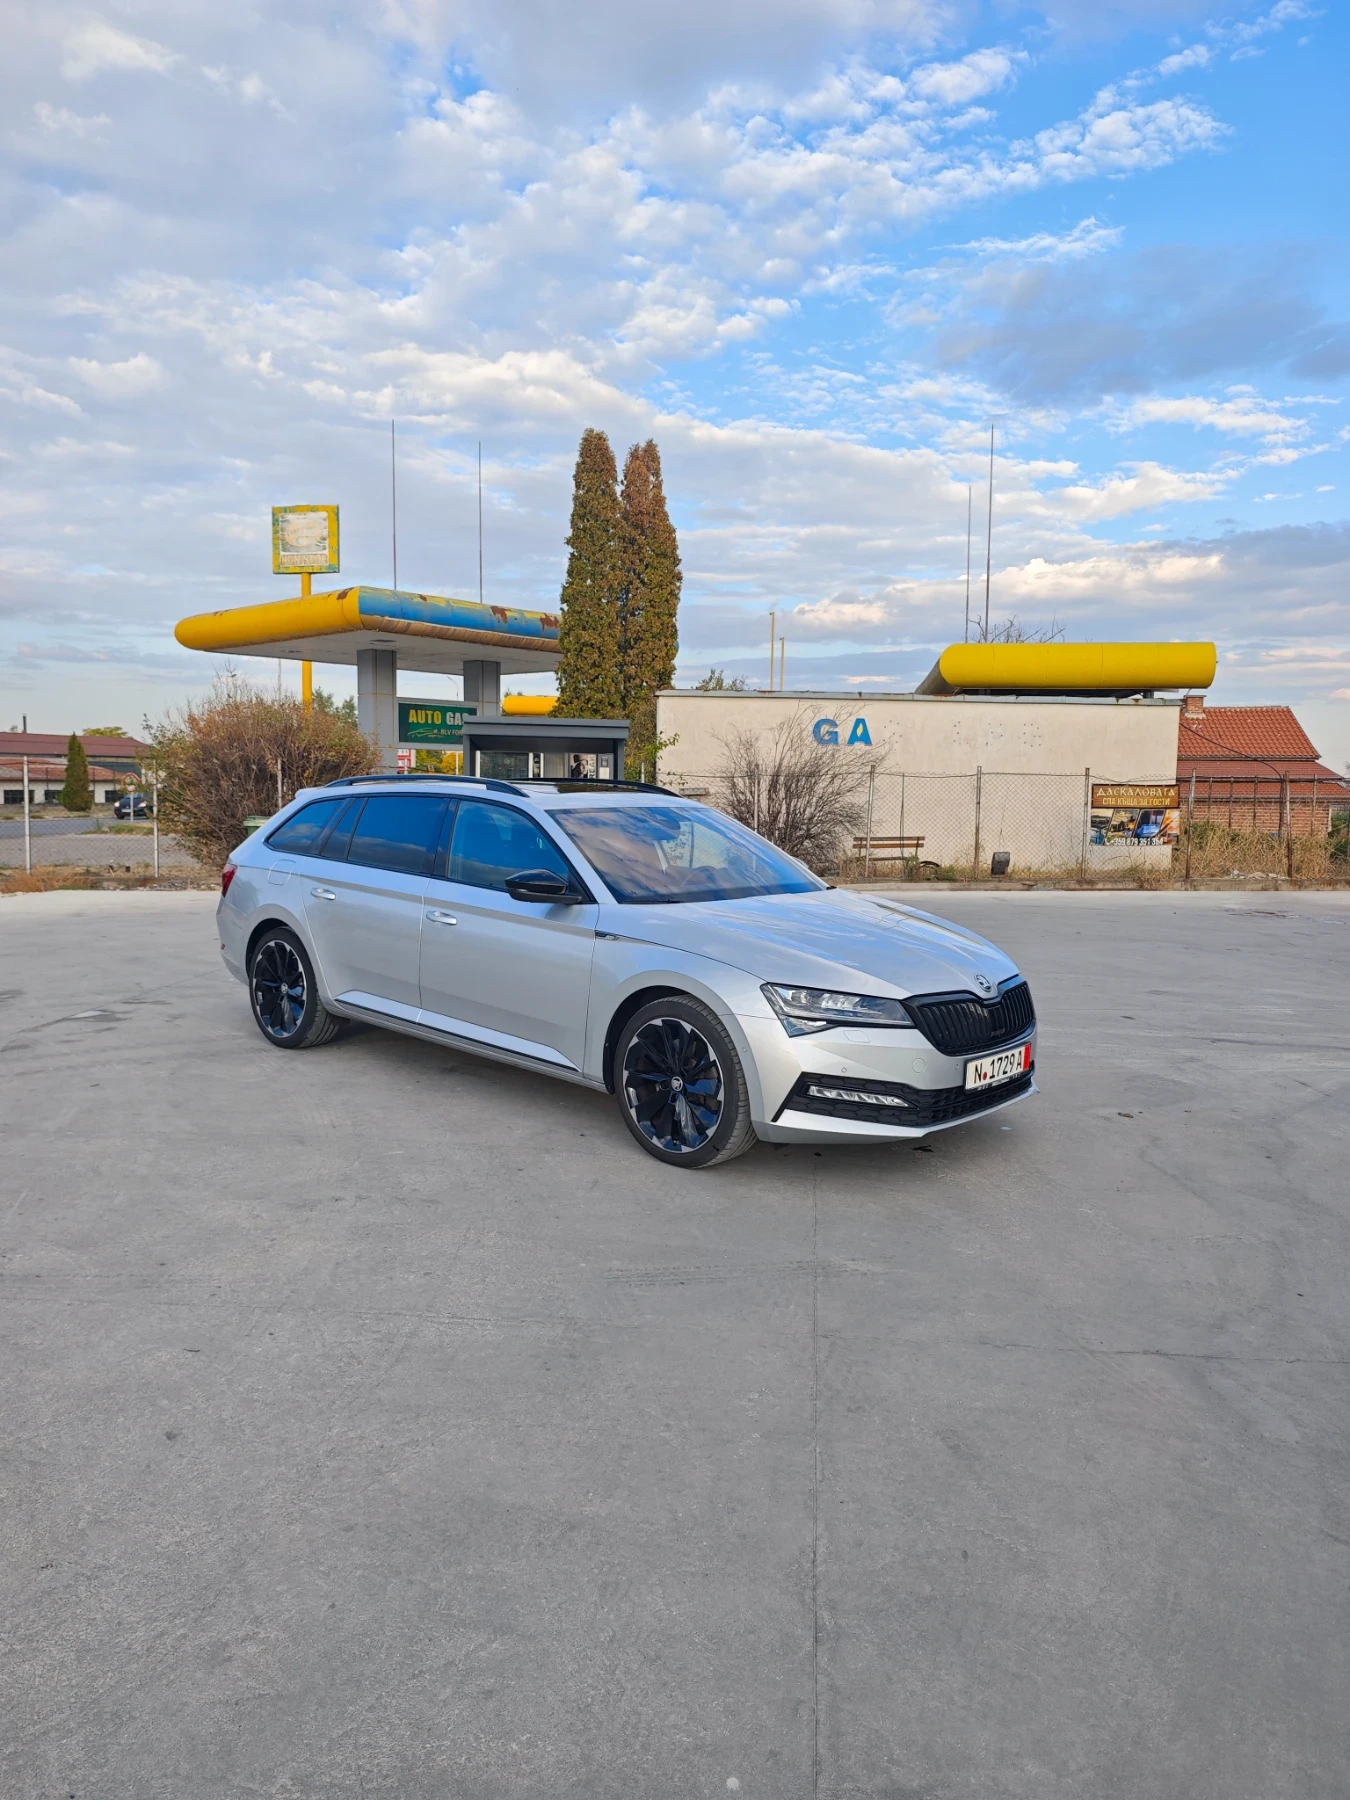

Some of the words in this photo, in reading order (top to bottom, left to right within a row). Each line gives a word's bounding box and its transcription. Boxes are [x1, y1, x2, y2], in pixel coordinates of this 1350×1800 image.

[408, 709, 442, 725] AUTO
[812, 718, 873, 747] GA
[1096, 787, 1176, 797] ДАСКАЛОВАТА
[1102, 797, 1116, 805] СПА
[1117, 797, 1137, 806] КЪЩА
[1138, 798, 1148, 806] ЗА
[1149, 798, 1171, 806] ГОСТИ
[974, 1062, 982, 1084] N
[989, 1053, 1015, 1080] 1729
[1016, 1050, 1022, 1071] A
